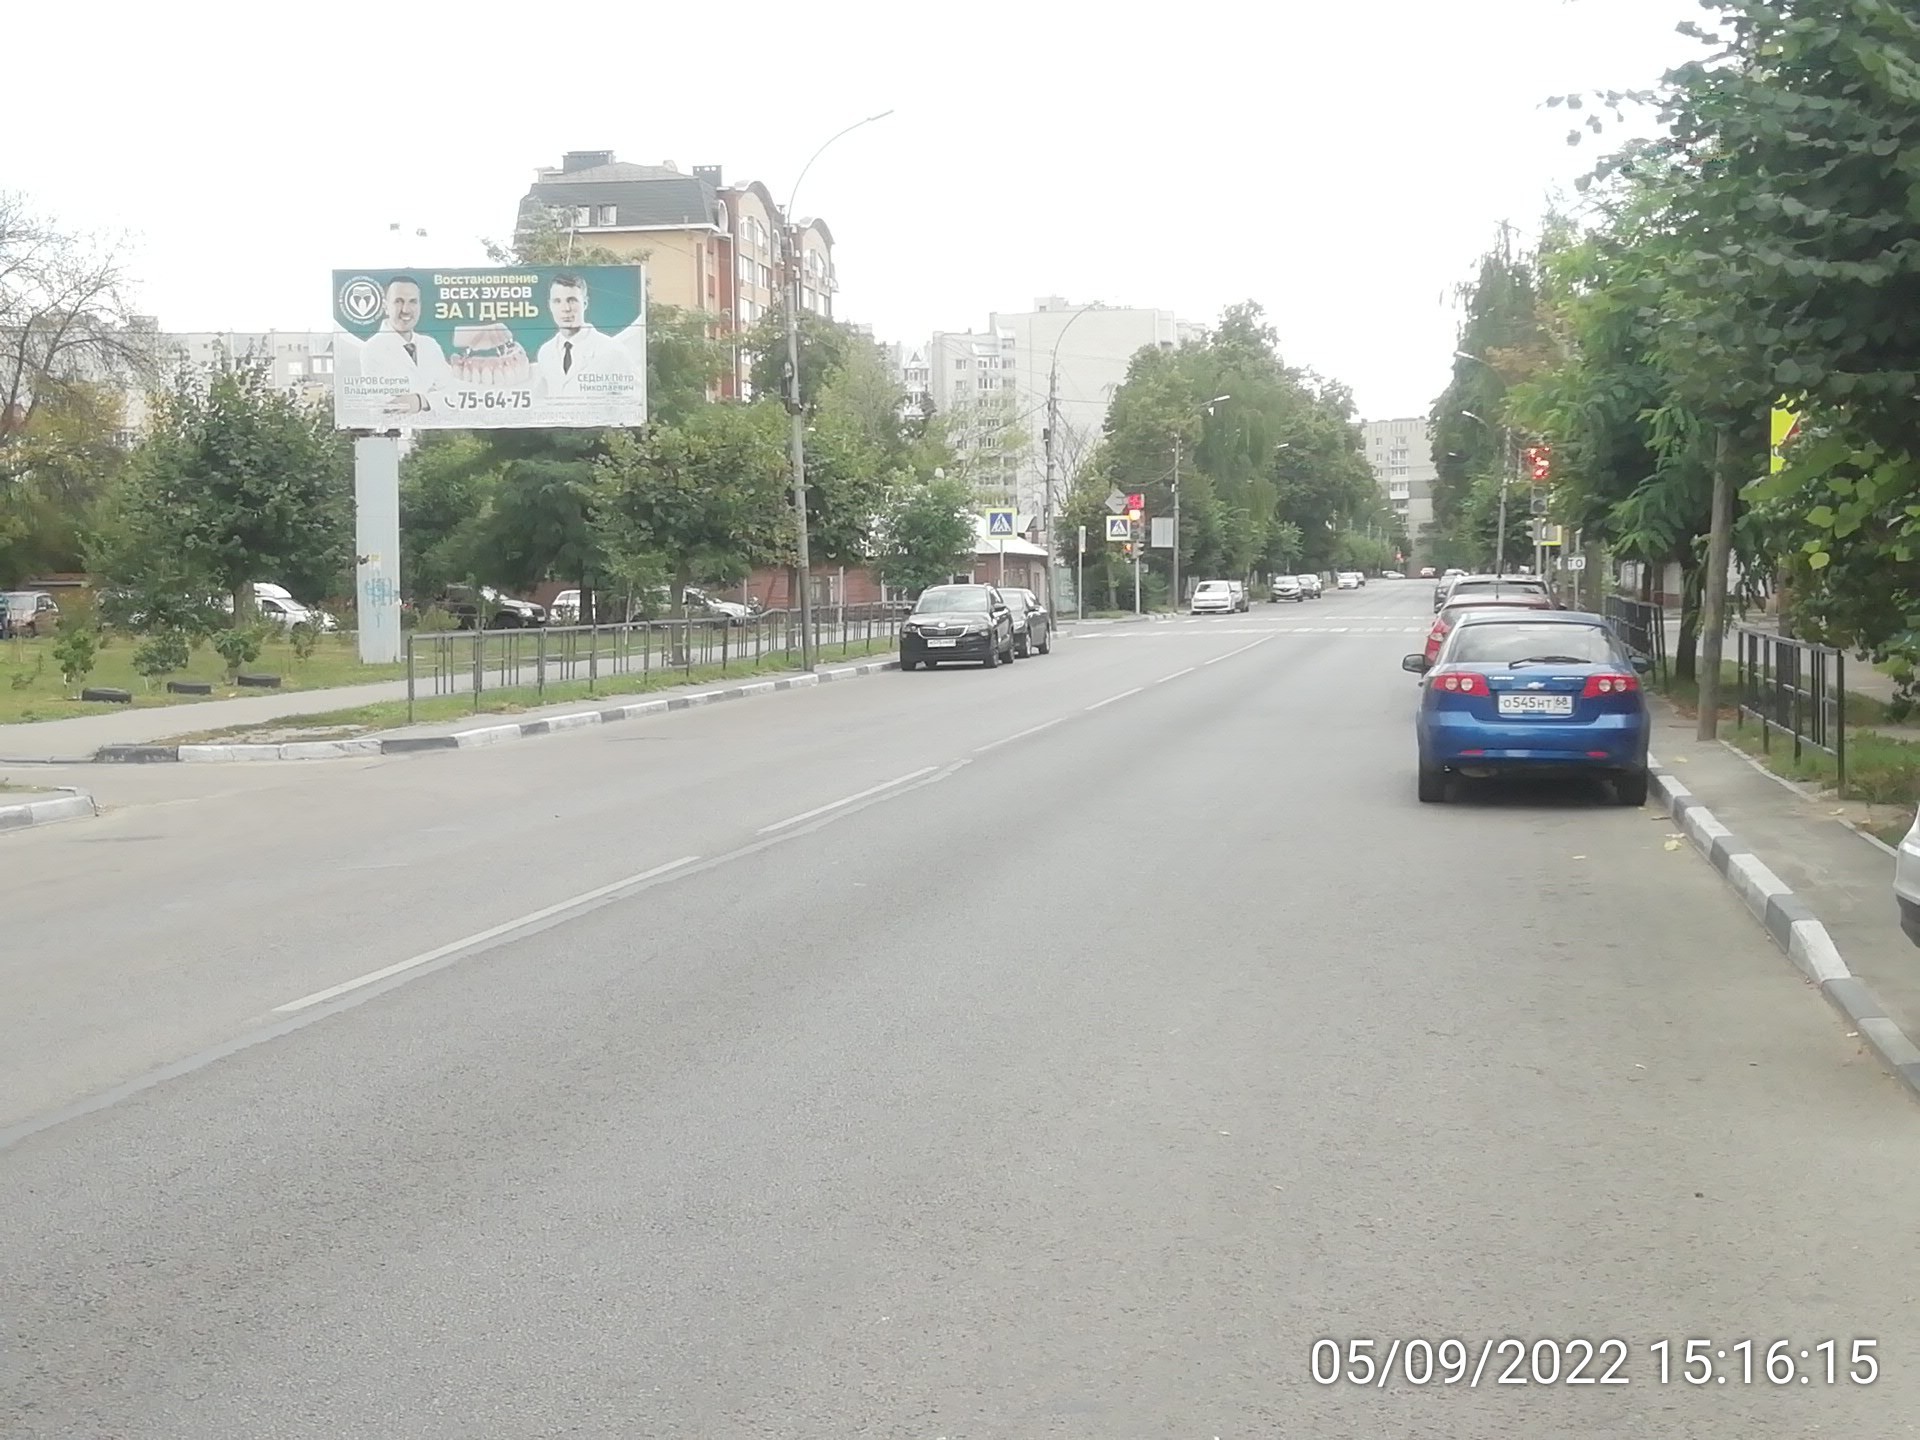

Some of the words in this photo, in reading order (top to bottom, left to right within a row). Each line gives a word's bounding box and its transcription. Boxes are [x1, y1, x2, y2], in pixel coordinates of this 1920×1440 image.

[434, 274, 539, 285] Восстановление
[440, 287, 479, 300] ВСЕХ
[481, 286, 532, 299] ЗУБОВ
[435, 302, 464, 319] ЗА
[467, 302, 475, 318] 1
[479, 301, 539, 321] ДЕНЬ
[343, 376, 378, 386] ЩУРОВ
[379, 376, 410, 386] Сергей
[577, 373, 611, 383] СЕДЫХ
[344, 386, 410, 396] Владимирович
[579, 383, 634, 392] Николаевич
[458, 391, 531, 409] 75-64-75
[1503, 697, 1552, 708] О545НТ
[1555, 696, 1568, 706] 68
